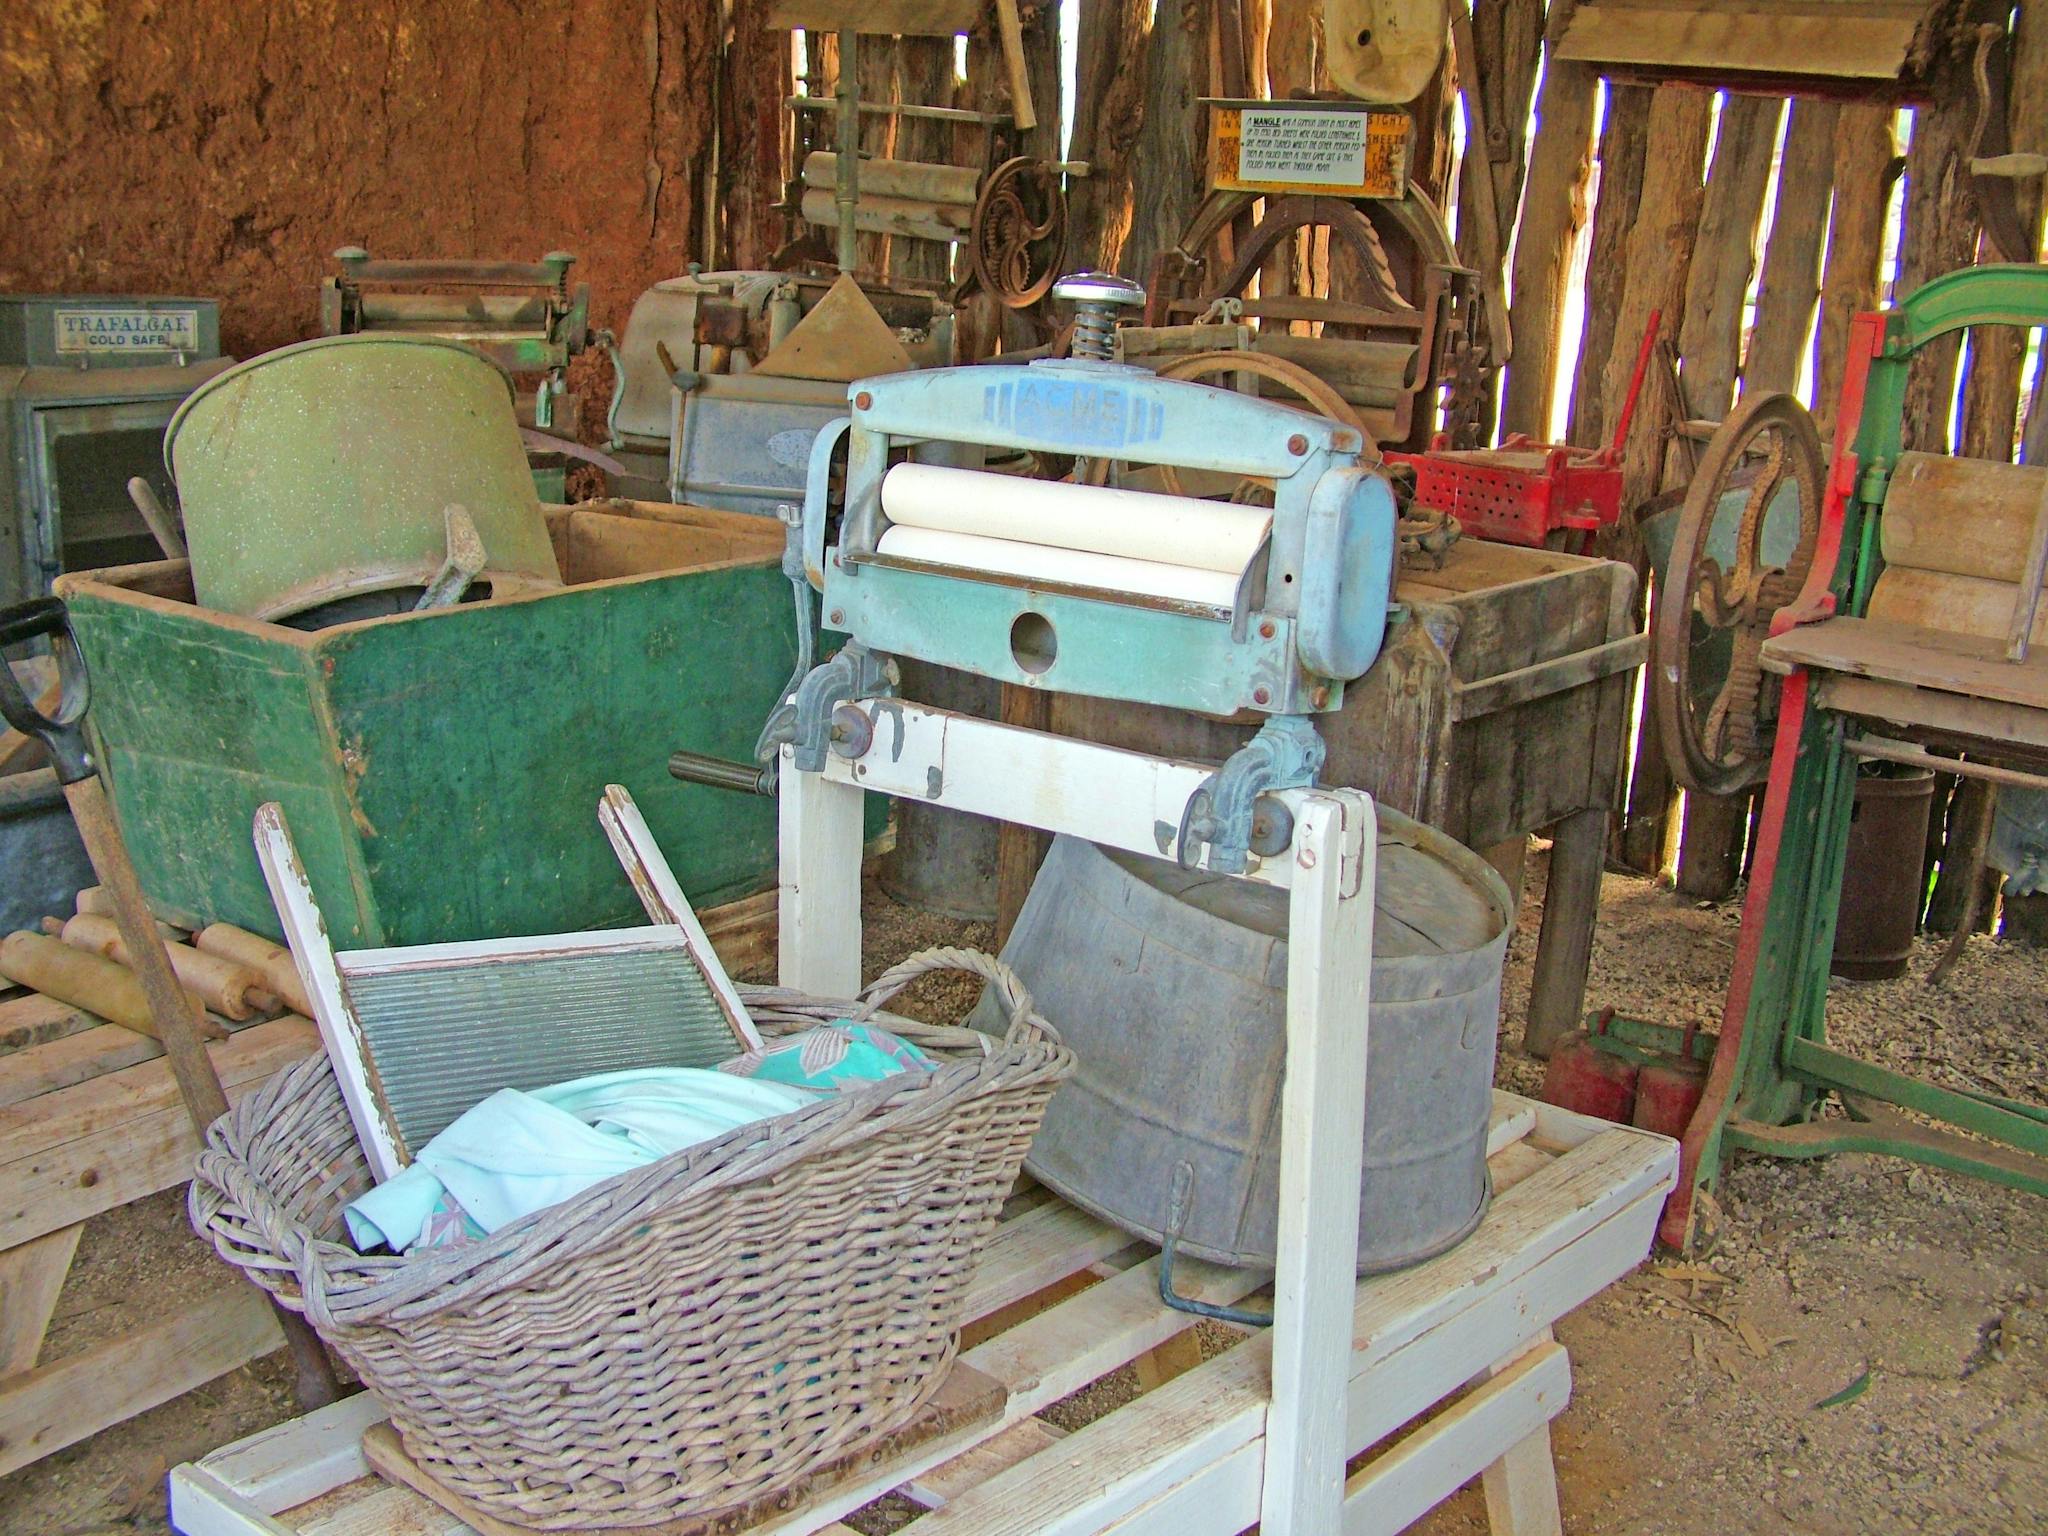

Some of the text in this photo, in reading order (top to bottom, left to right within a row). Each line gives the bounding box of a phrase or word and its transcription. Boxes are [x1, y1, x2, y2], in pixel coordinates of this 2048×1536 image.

[1253, 117, 1280, 127] MANGLE
[1367, 114, 1403, 125] SIGHT
[1299, 130, 1310, 138] WERE
[1311, 130, 1327, 138] FOLDED
[1366, 134, 1405, 145] SHEETS
[1318, 141, 1332, 150] OTHER
[1333, 142, 1351, 150] PERSON
[1351, 142, 1361, 151] FED
[1312, 152, 1325, 160] CAME
[64, 317, 188, 332] TRAFALGAR
[89, 335, 168, 345] COLD SAFE
[1022, 383, 1120, 422] ACME
